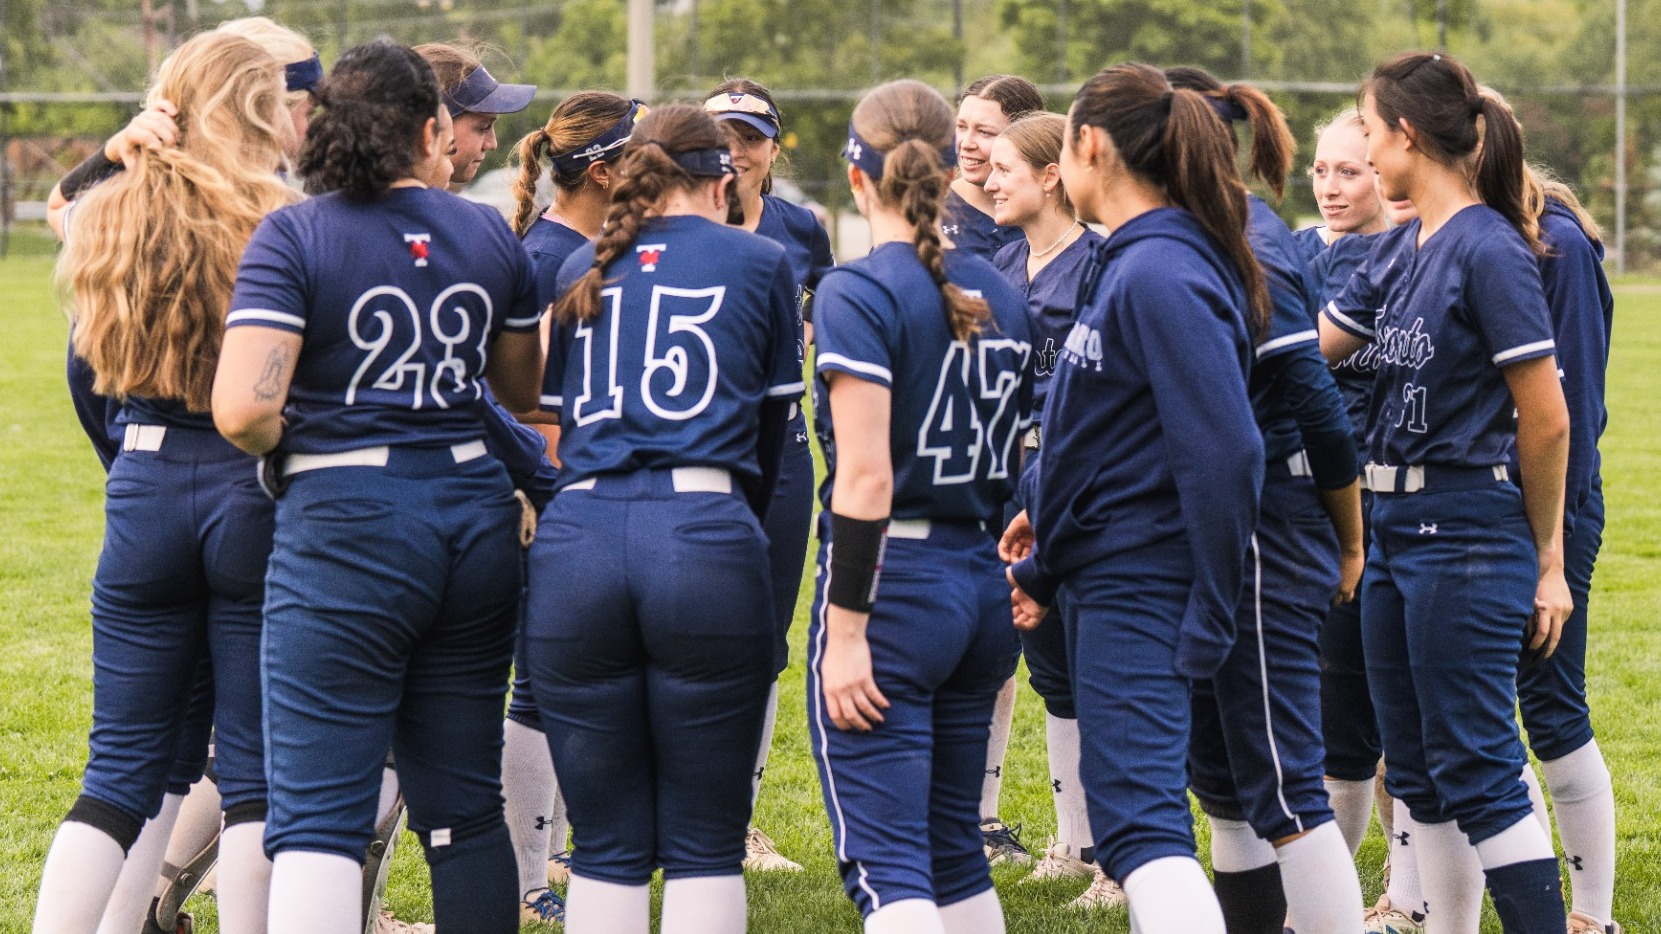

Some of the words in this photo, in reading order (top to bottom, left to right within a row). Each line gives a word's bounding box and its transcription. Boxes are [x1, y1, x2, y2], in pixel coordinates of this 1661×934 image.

[345, 282, 493, 410] 23
[573, 285, 726, 427] 15
[917, 338, 1032, 486] 47
